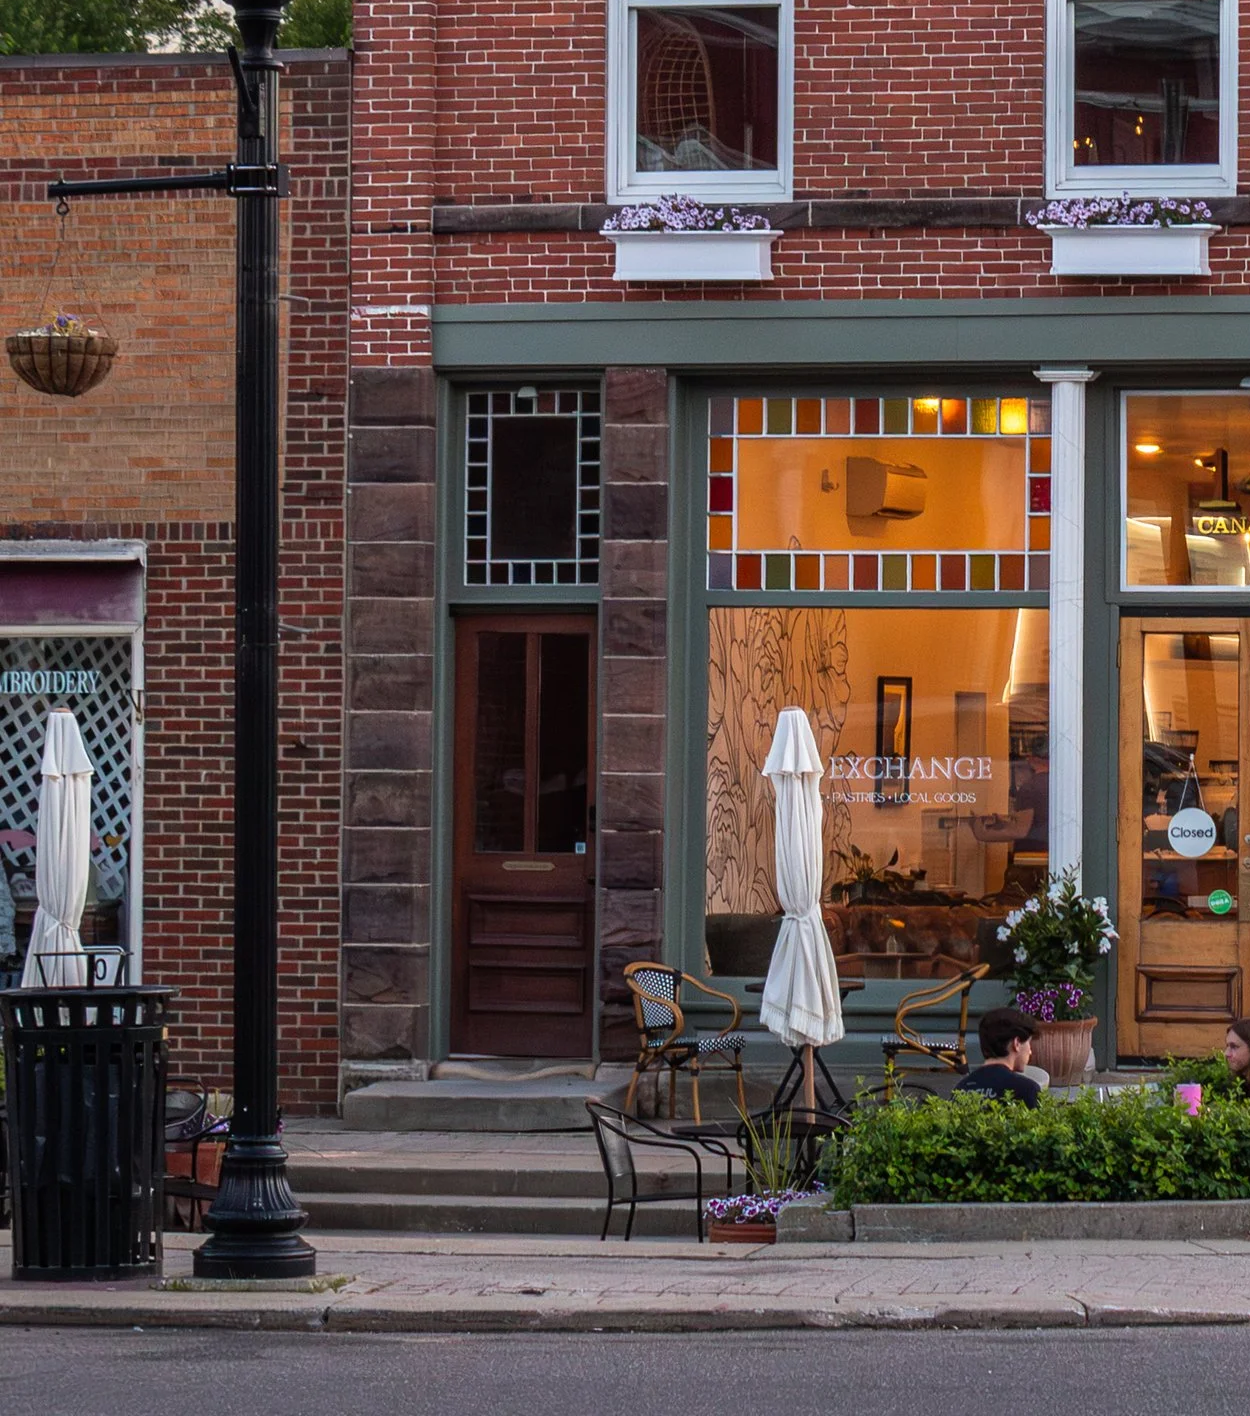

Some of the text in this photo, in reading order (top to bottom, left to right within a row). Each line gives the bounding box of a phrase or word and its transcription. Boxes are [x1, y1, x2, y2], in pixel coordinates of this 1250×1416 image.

[828, 756, 992, 780] EXCHANGE
[832, 792, 886, 803] PASTRIES
[894, 792, 932, 803] LOCAL
[934, 792, 977, 803] GOODS
[1171, 827, 1213, 838] Closed
